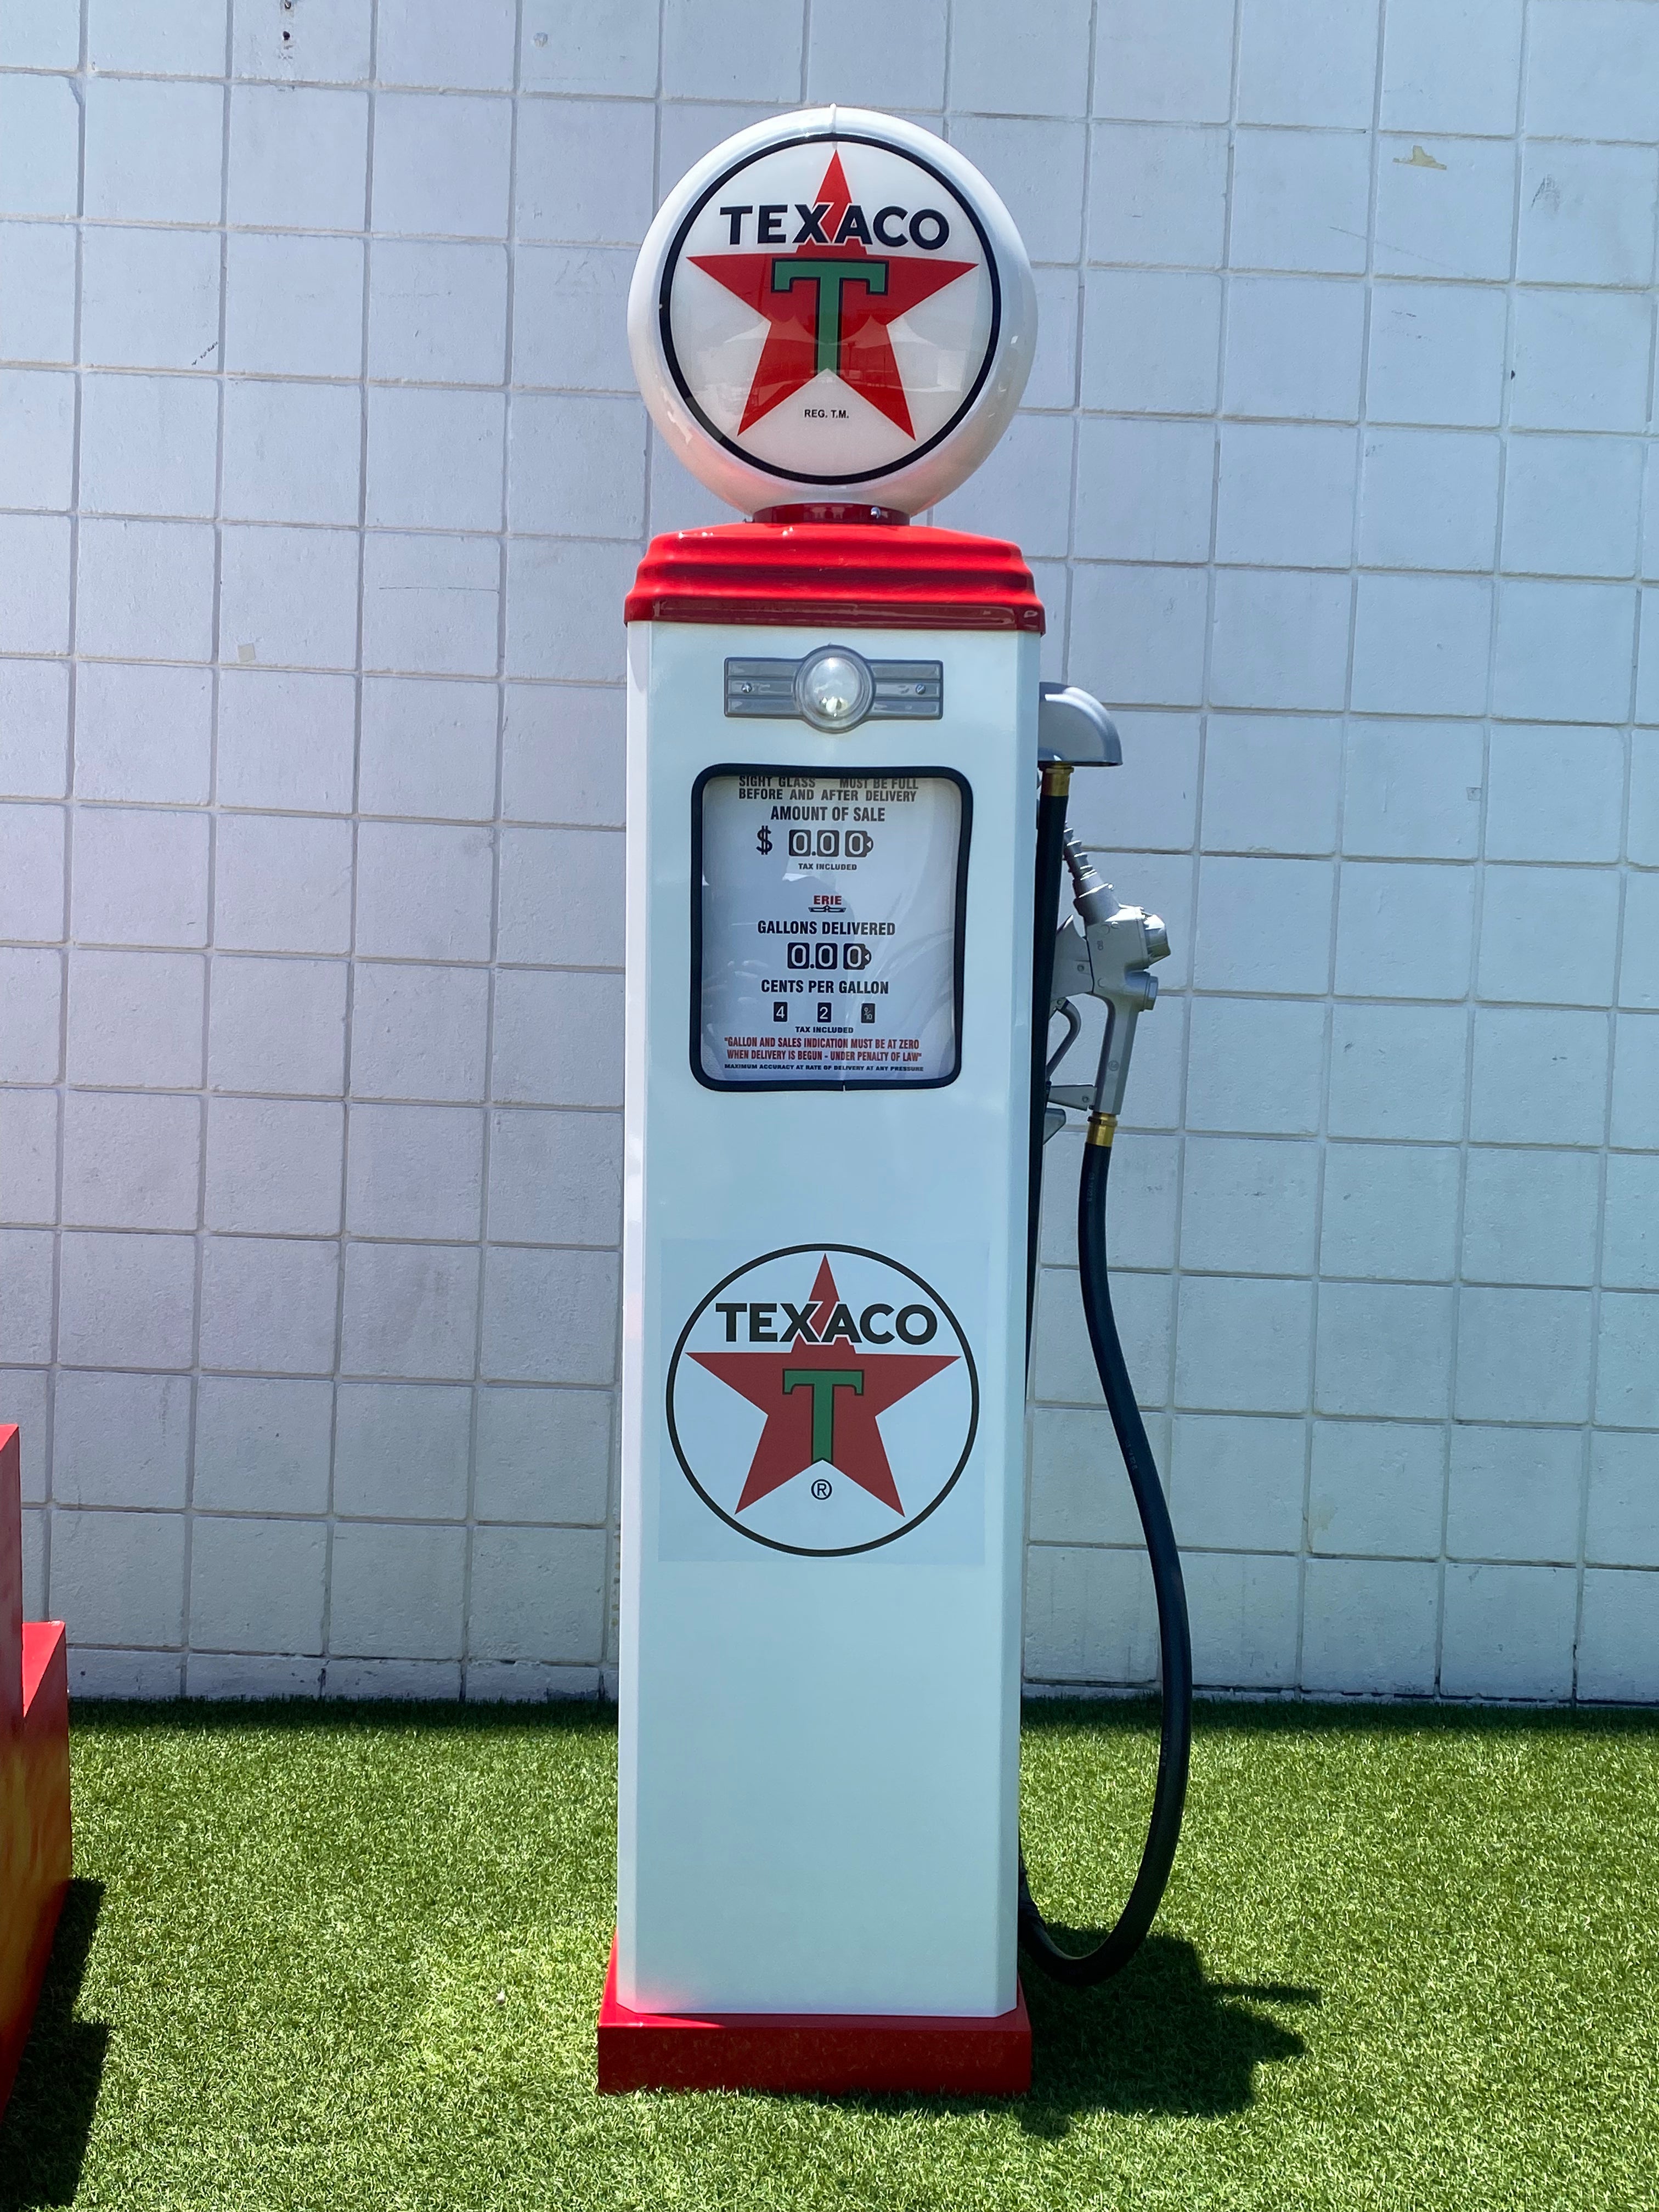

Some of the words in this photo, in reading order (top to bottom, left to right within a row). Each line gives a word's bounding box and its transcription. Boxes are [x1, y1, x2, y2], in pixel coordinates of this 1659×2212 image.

[720, 204, 950, 250] TEXACO
[771, 257, 890, 375] T
[804, 409, 828, 418] REG.
[831, 410, 849, 419] T.M.
[738, 776, 772, 787] SIGHT
[778, 777, 816, 788] GLASS
[839, 778, 869, 789] MUST
[873, 778, 888, 789] BE
[891, 778, 919, 789] FULL
[738, 788, 783, 800] BEFORE
[789, 789, 814, 800] AND
[820, 789, 859, 802] AFTER
[865, 790, 917, 802] DELIVERY
[770, 806, 828, 821] AMOUNT
[832, 807, 850, 822] OF
[853, 807, 885, 822] SALE
[756, 826, 773, 855] $
[816, 863, 857, 871] INCLUDED
[813, 895, 843, 906] ERIE
[758, 920, 817, 935] GALLONS
[822, 921, 896, 936] DELIVERED
[761, 980, 804, 994] CENTS
[808, 981, 834, 994] PER
[839, 981, 889, 995] GALLON
[775, 1004, 786, 1020] 4
[819, 1005, 830, 1020] 2
[759, 1037, 775, 1047] AND
[777, 1037, 802, 1048] SALES
[804, 1037, 848, 1048] INDICATION
[850, 1038, 873, 1049] MUST
[875, 1039, 885, 1049] BE
[887, 1039, 898, 1049] AT
[899, 1039, 919, 1049] ZERO
[727, 1049, 749, 1060] WHEN
[751, 1049, 786, 1060] DELIVERY
[788, 1050, 795, 1060] IS
[797, 1051, 822, 1060] BEGUN
[830, 1051, 855, 1061] UNDER
[857, 1051, 889, 1062] PENALTY
[890, 1052, 900, 1062] OF
[715, 1302, 938, 1345] TEXACO
[782, 1368, 865, 1466] T
